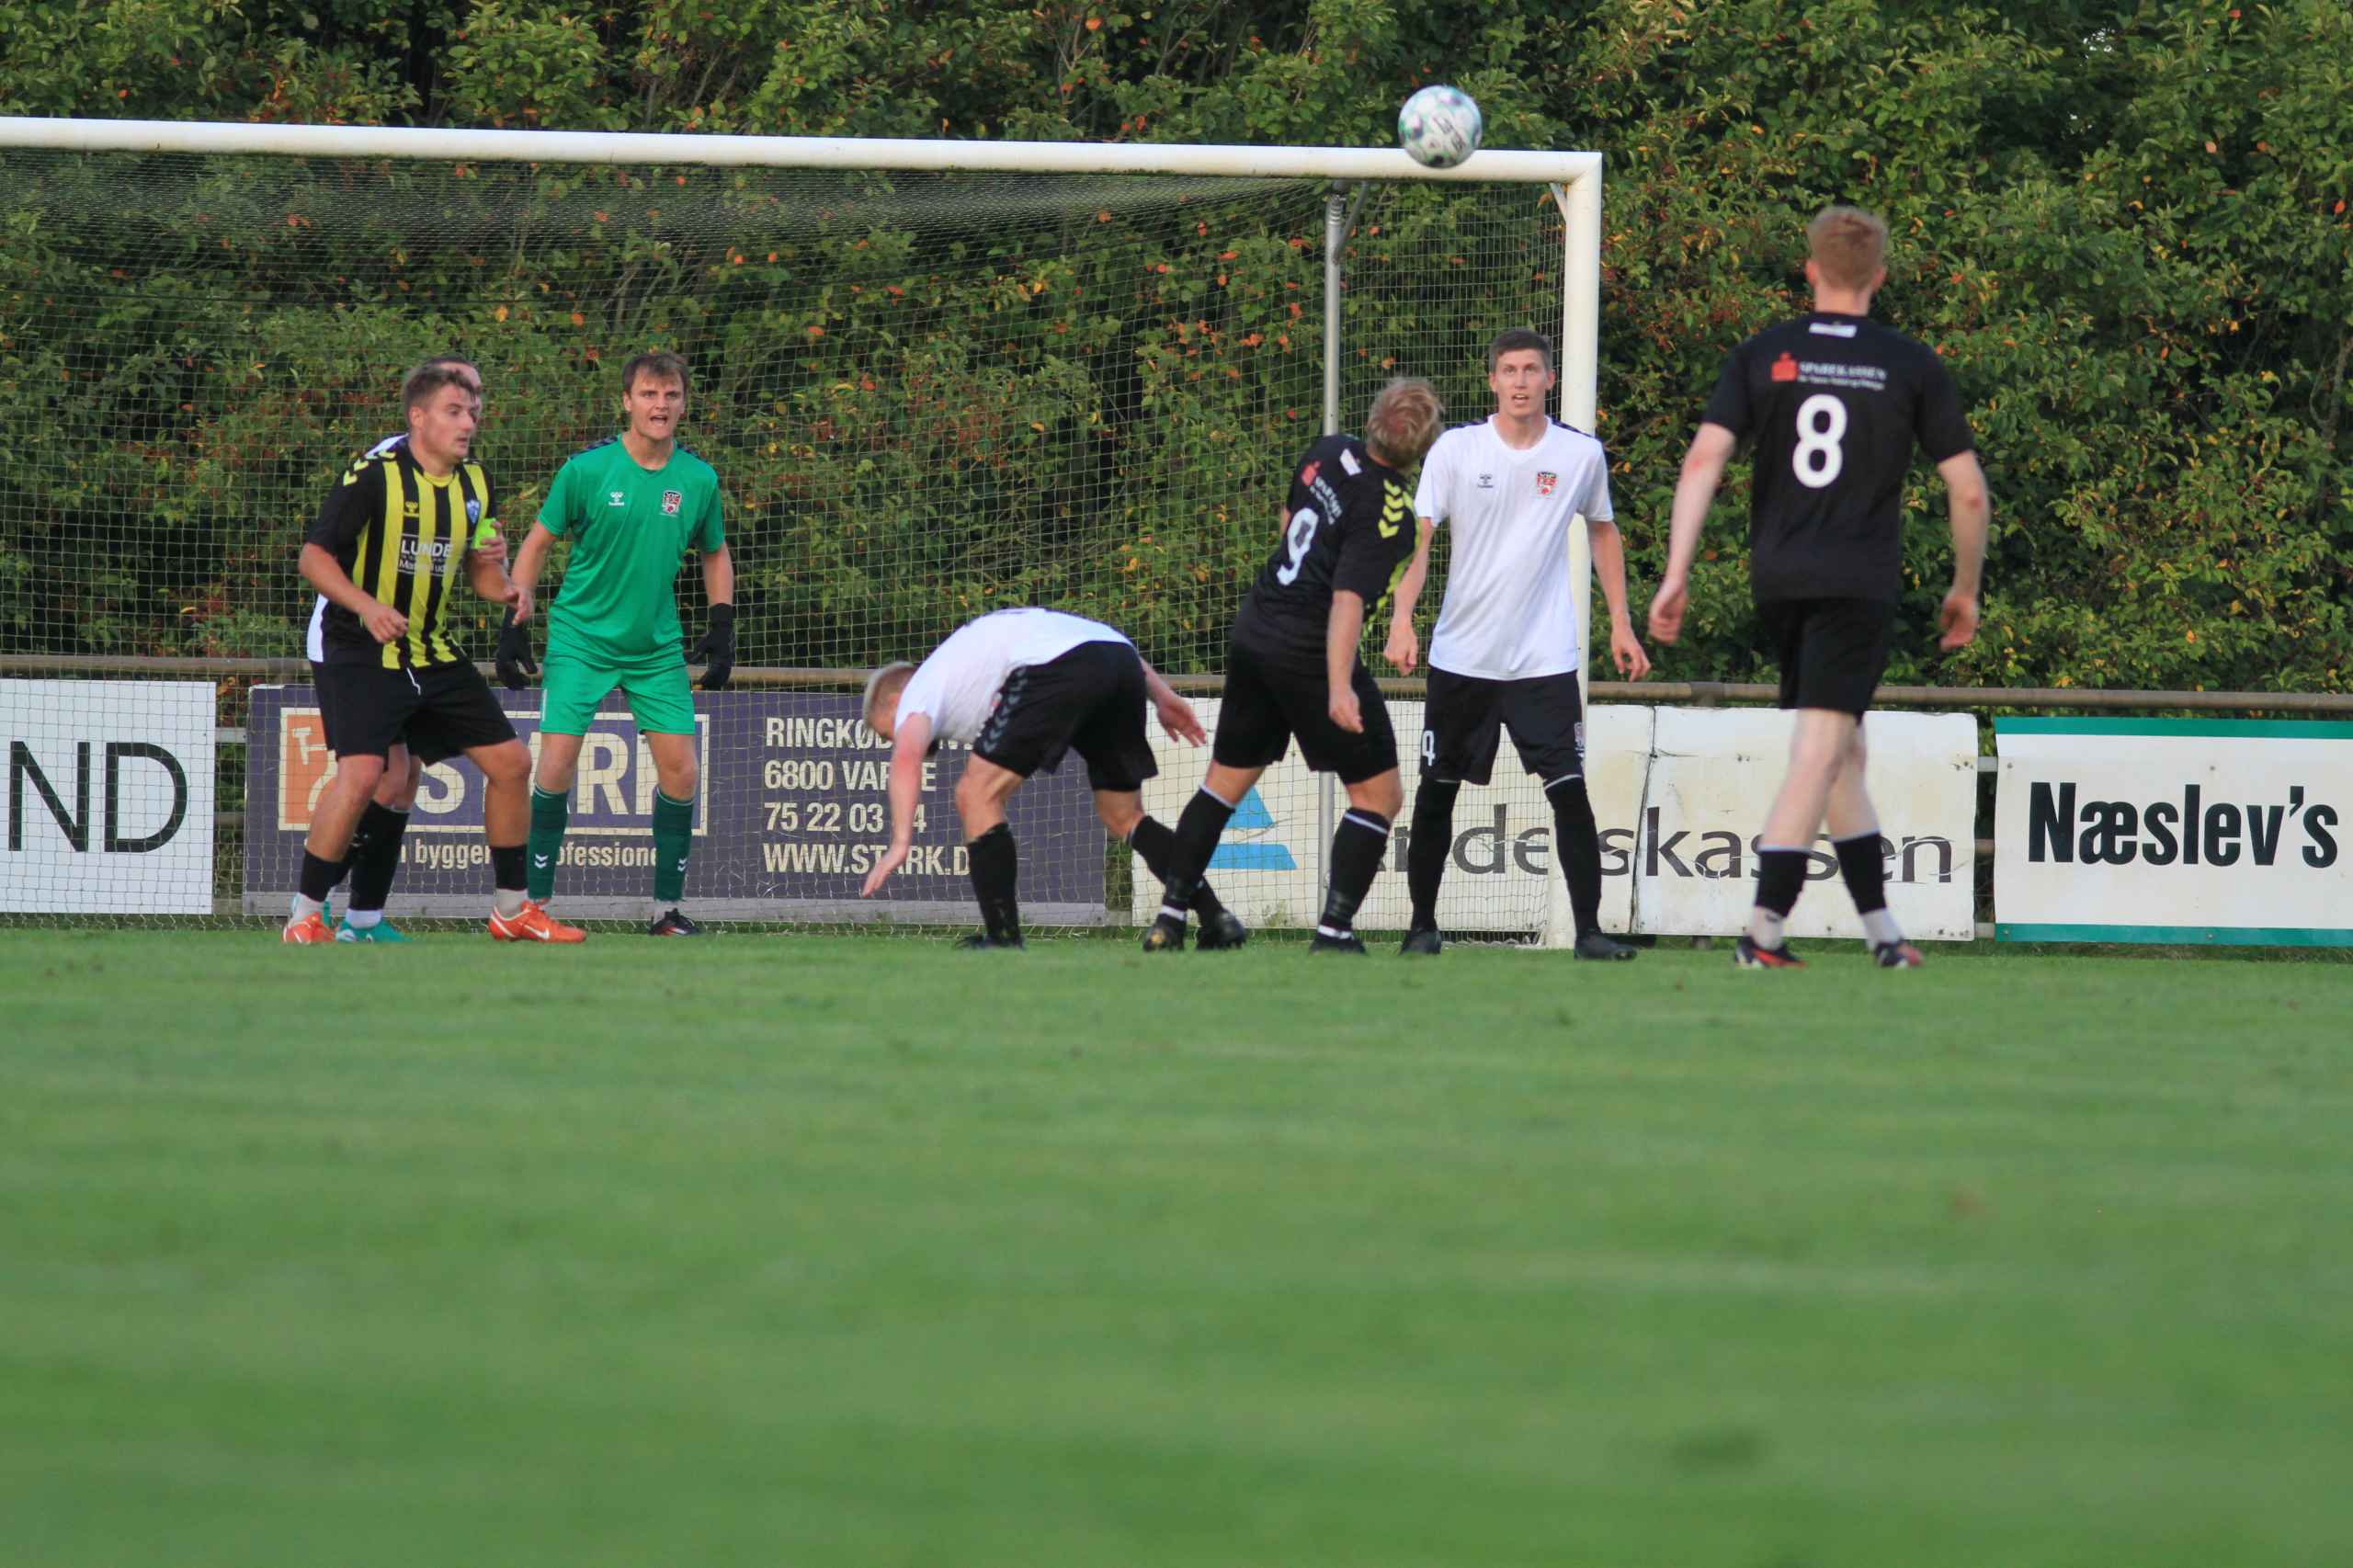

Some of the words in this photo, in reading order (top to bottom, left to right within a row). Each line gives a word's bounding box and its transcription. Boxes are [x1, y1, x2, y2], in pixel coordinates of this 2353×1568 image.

[1793, 393, 1847, 488] 8
[401, 539, 454, 559] LUNDE
[1276, 507, 1319, 586] 9
[8, 741, 188, 853] ND
[764, 759, 834, 790] 6800
[841, 760, 938, 791] VAE
[764, 801, 798, 832] 75
[806, 801, 841, 832] 22
[848, 802, 883, 833] 03
[2029, 781, 2338, 869] Næslev's
